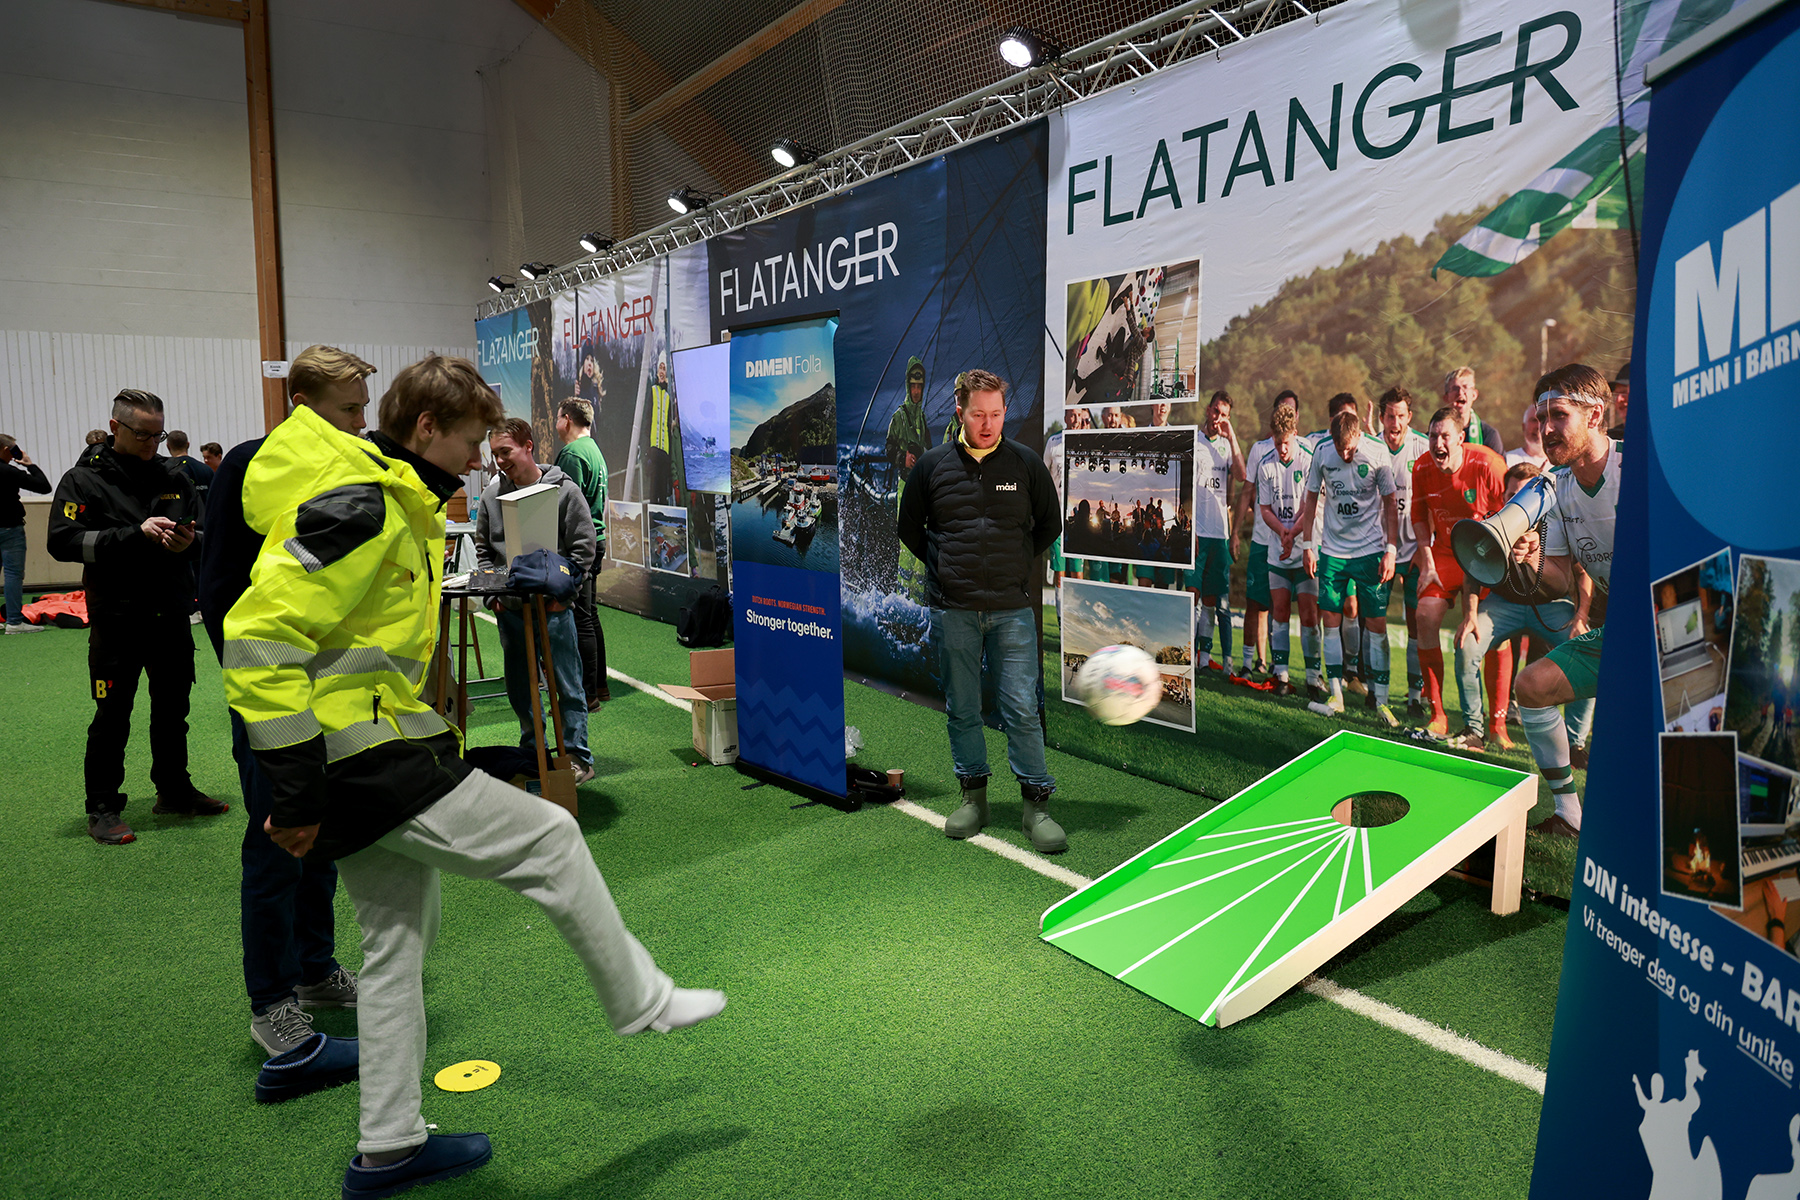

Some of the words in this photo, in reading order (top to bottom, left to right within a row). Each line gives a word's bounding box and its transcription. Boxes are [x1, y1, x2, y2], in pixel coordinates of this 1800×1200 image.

[1067, 10, 1582, 236] FLATANGER
[720, 221, 900, 316] FLATANGER
[563, 294, 654, 351] FLATANGER
[745, 356, 793, 379] DAMEN
[795, 354, 822, 374] Folla
[1672, 361, 1730, 409] MENN
[1204, 477, 1221, 489] AQS
[1278, 506, 1294, 519] AQS
[1337, 502, 1359, 516] AQS
[746, 608, 786, 631] Stronger
[787, 617, 834, 640] together.
[777, 600, 802, 612] NORWEGIAN
[1583, 856, 1617, 905] DIN
[1620, 883, 1715, 972] interesse
[1583, 904, 1596, 931] Vi
[1596, 918, 1646, 969] trenger
[1647, 957, 1676, 996] deg
[1679, 984, 1700, 1015] og
[1704, 1000, 1733, 1037] din
[1738, 1026, 1795, 1081] unike
